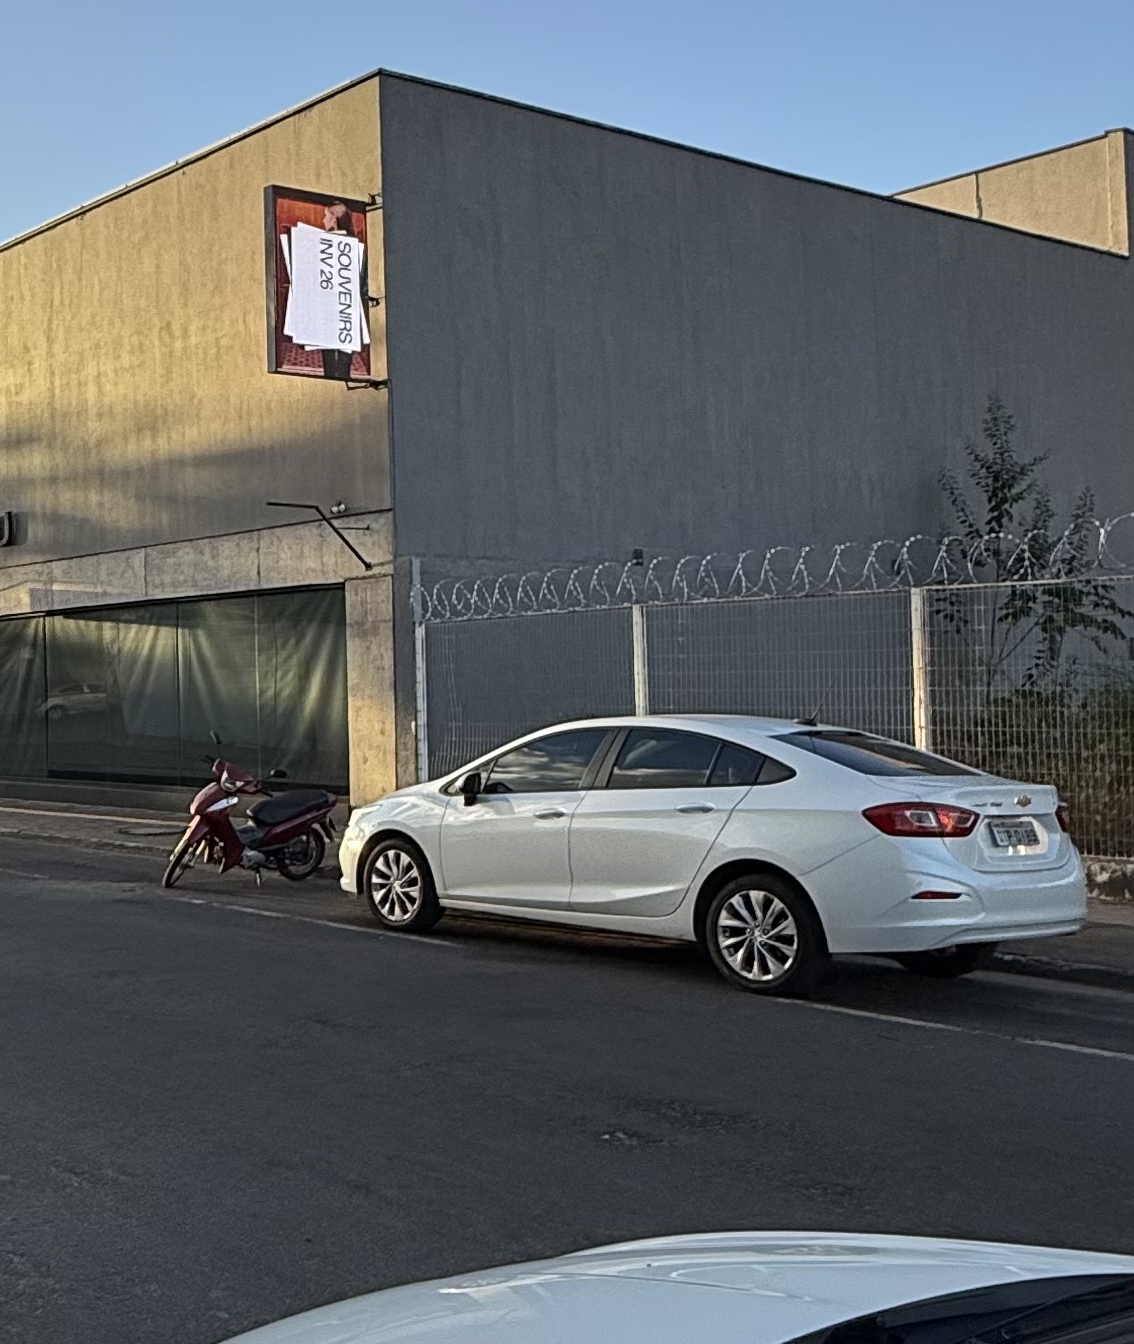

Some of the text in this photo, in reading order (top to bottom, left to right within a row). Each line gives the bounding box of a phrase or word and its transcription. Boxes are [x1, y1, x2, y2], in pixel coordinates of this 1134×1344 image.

[319, 238, 334, 290] INV 26
[337, 240, 353, 344] SOUVENIRS
